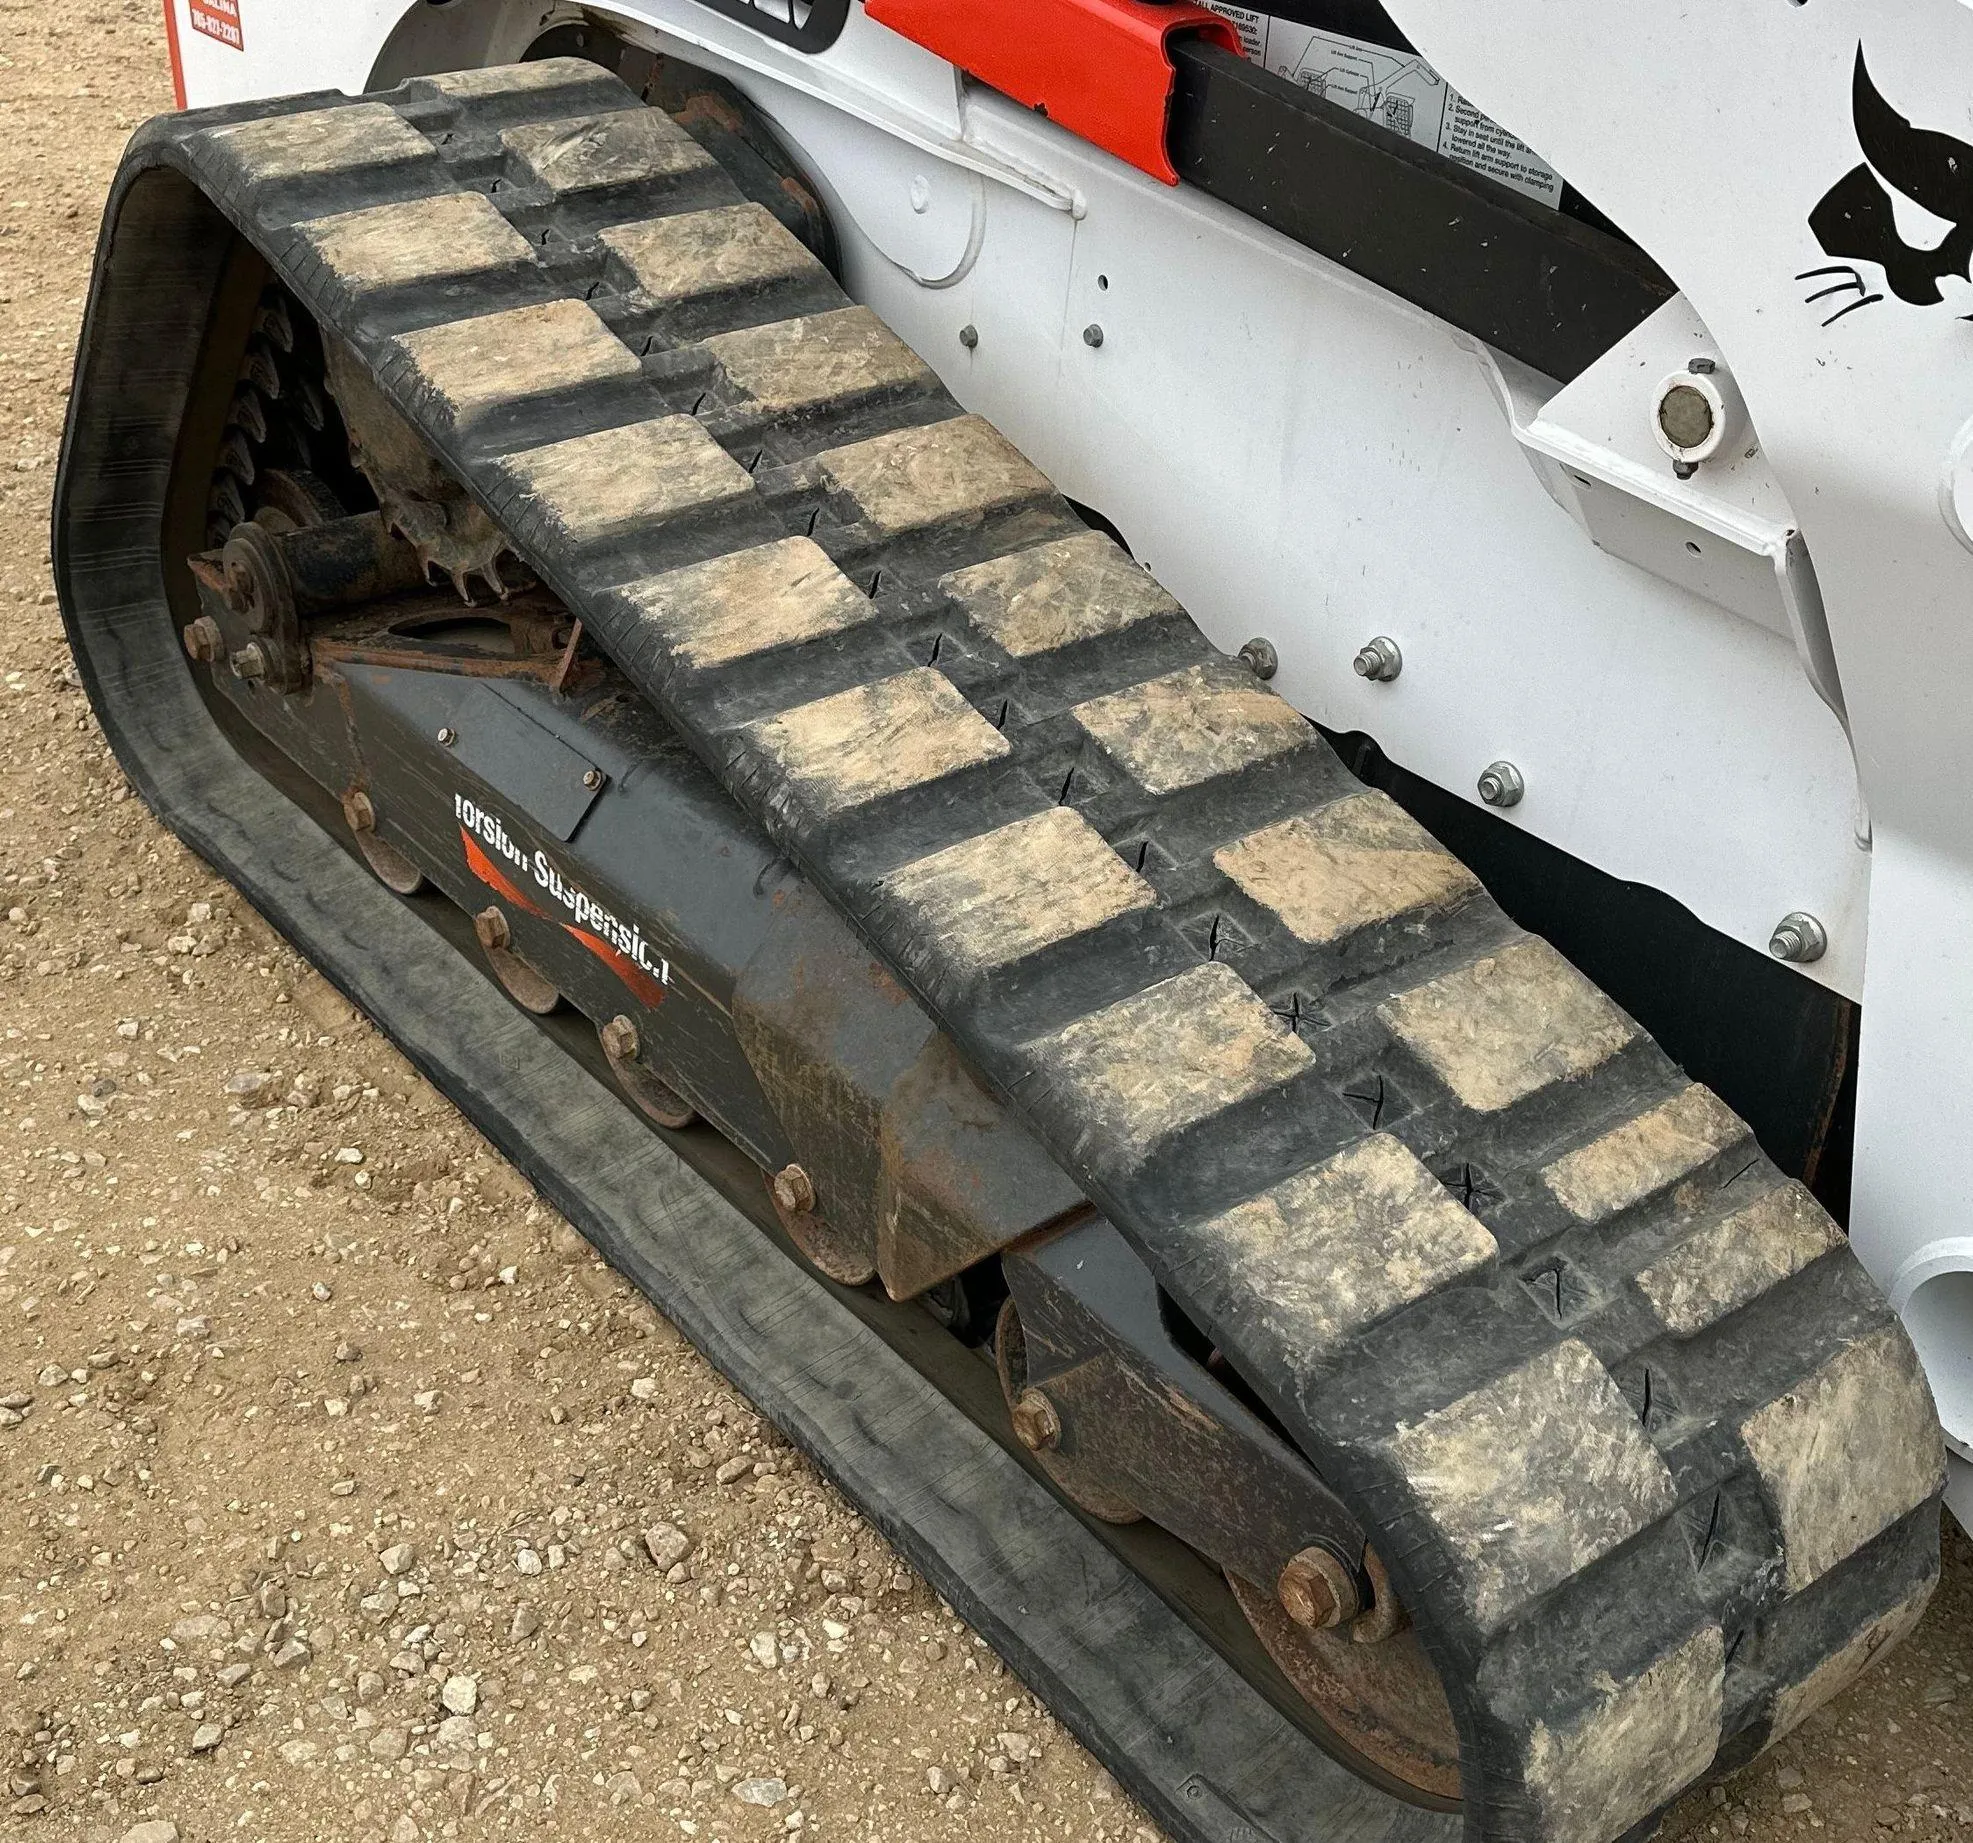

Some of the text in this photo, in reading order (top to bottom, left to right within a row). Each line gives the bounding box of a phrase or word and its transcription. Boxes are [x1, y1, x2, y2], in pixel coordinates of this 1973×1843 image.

[1210, 4, 1245, 19] APPROVED
[1246, 13, 1259, 24] LIFT
[1455, 106, 1479, 118] Second
[1446, 122, 1451, 130] 3.
[1453, 125, 1467, 136] Stay
[1469, 129, 1474, 137] in
[1475, 131, 1489, 142] seat
[1490, 136, 1503, 146] until
[1505, 139, 1515, 149] the
[1480, 122, 1494, 133] from
[1452, 134, 1476, 148] lowered
[1477, 142, 1485, 150] all
[1486, 144, 1496, 153] the
[1443, 141, 1552, 183] 4. Return lift arm support to storage
[1475, 160, 1486, 170] and
[1488, 165, 1509, 177] secure
[1510, 172, 1523, 182] with
[1524, 176, 1554, 193] clamping
